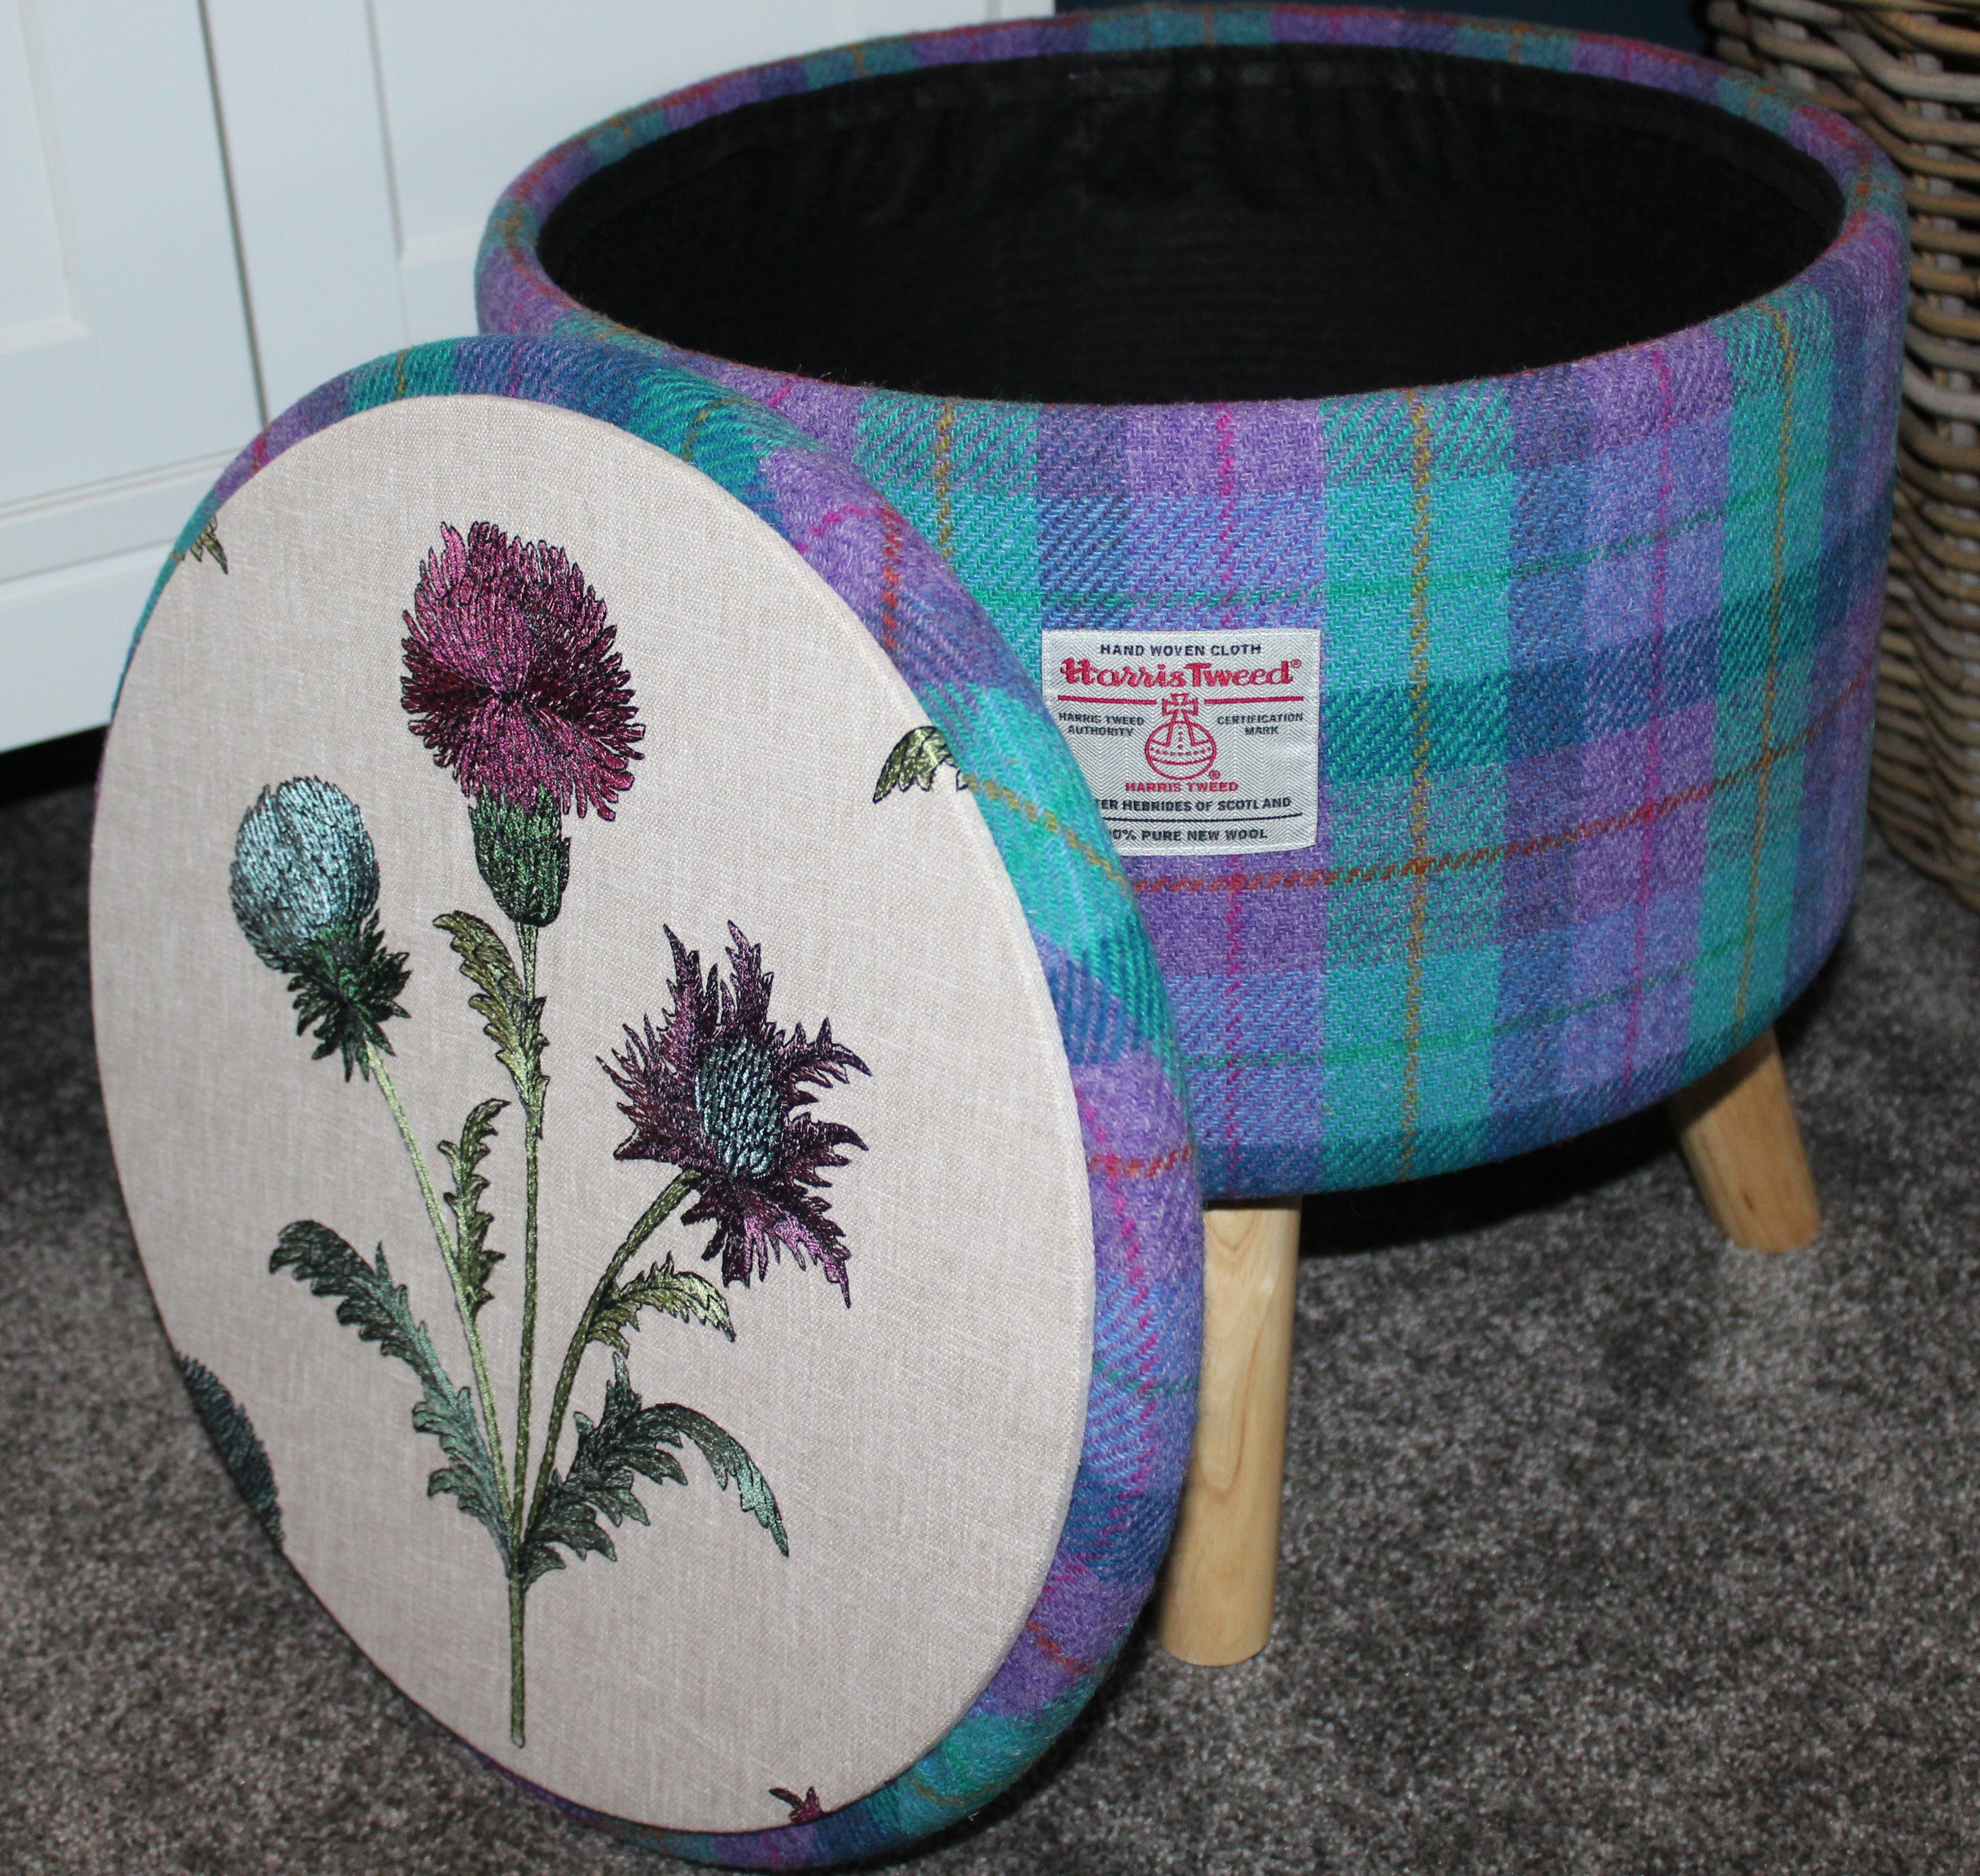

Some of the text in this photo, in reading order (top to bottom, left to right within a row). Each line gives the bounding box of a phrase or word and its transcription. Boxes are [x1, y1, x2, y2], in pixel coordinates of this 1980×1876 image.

[1100, 644, 1261, 656] HAND WOVEN CLOTH
[1060, 657, 1186, 688] Harris
[1058, 712, 1144, 726] HARRIS TWEED
[1217, 712, 1303, 725] CERTIFICATION
[1068, 725, 1134, 736] AUTHORITY
[1245, 726, 1279, 736] MARK
[1125, 782, 1238, 792] HARRIS TWEED
[1123, 800, 1193, 811] HEBRIDES
[1195, 801, 1213, 811] OF
[1217, 797, 1292, 811] SCOTLAND
[1110, 829, 1268, 841] 0% PURE NEW WOOL
